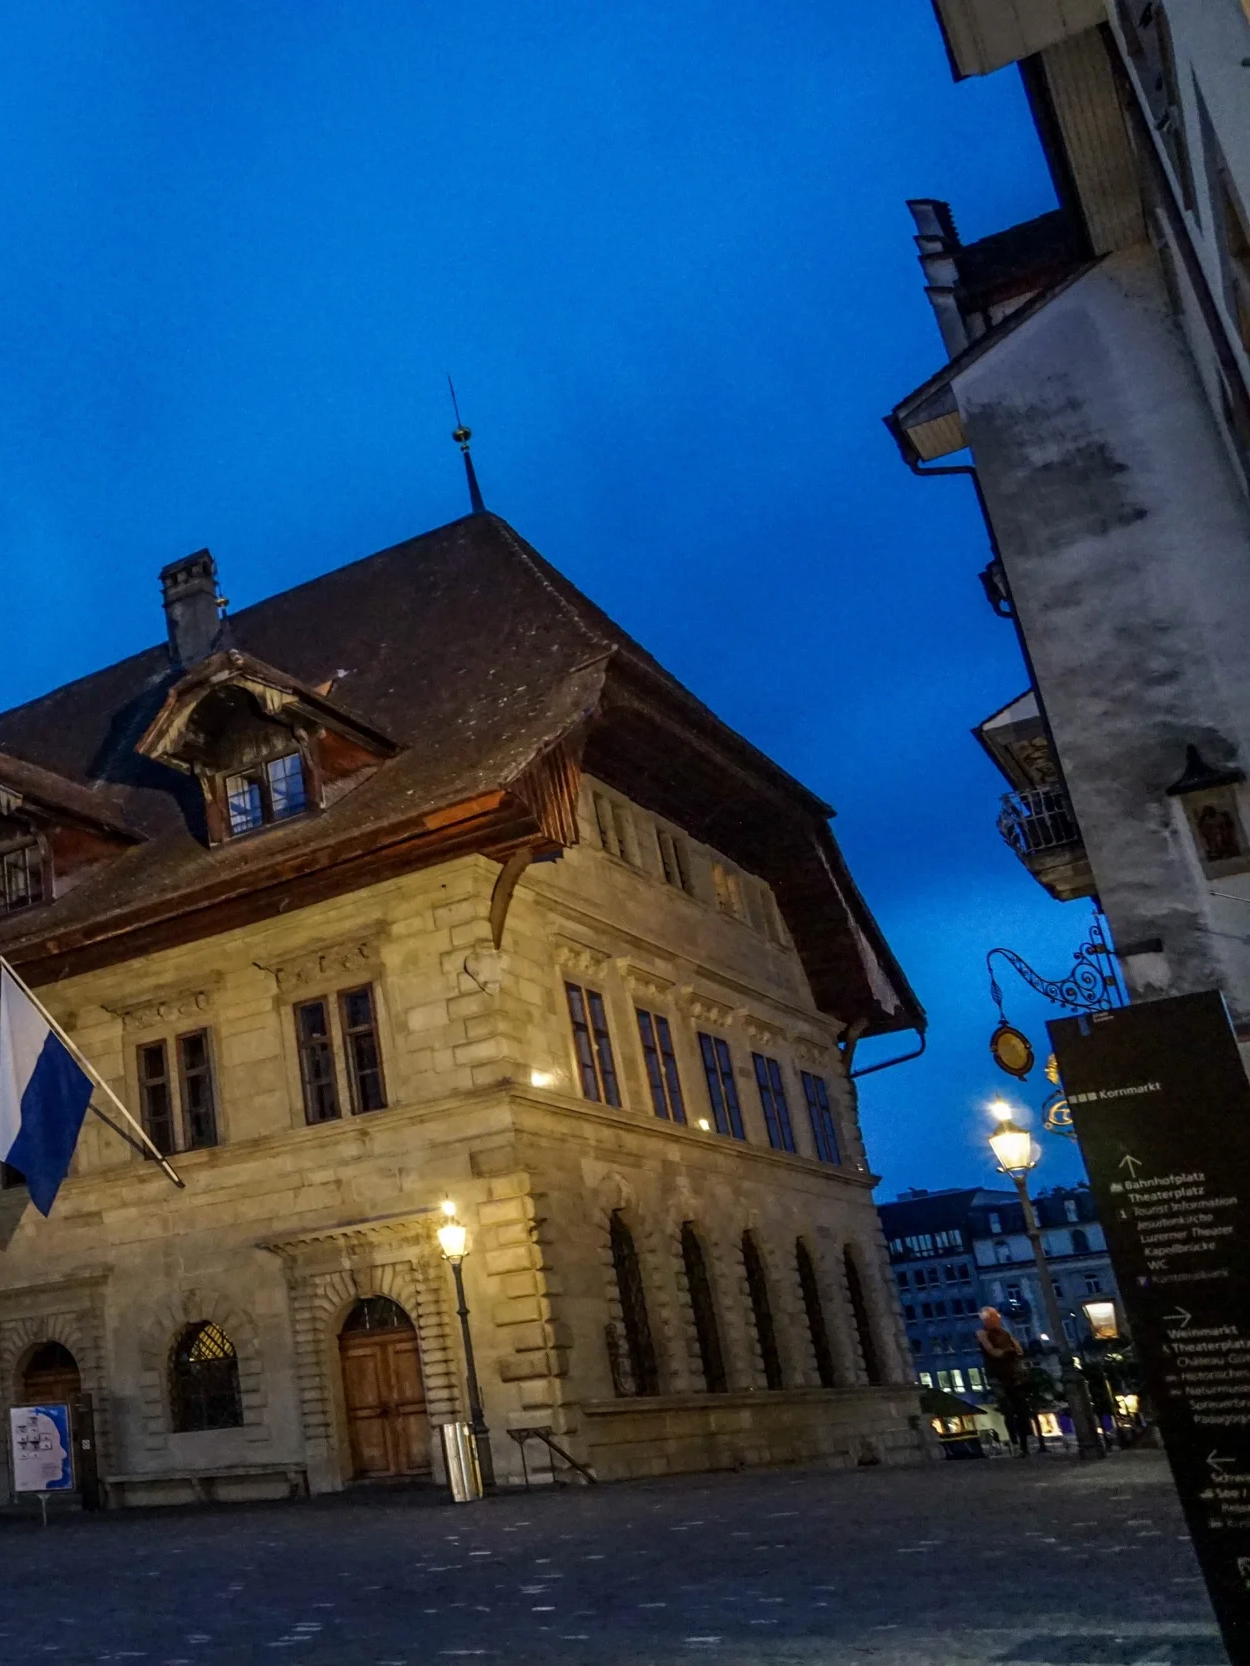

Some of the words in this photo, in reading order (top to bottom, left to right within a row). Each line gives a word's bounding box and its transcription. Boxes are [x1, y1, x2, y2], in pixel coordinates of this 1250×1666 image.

[1099, 1082, 1162, 1099] Kornmarkt
[1125, 1172, 1205, 1190] Bahnhofplatz
[1128, 1187, 1204, 1203] Theaterplatz
[1192, 1226, 1233, 1237] Theater
[1147, 1259, 1168, 1270] WC
